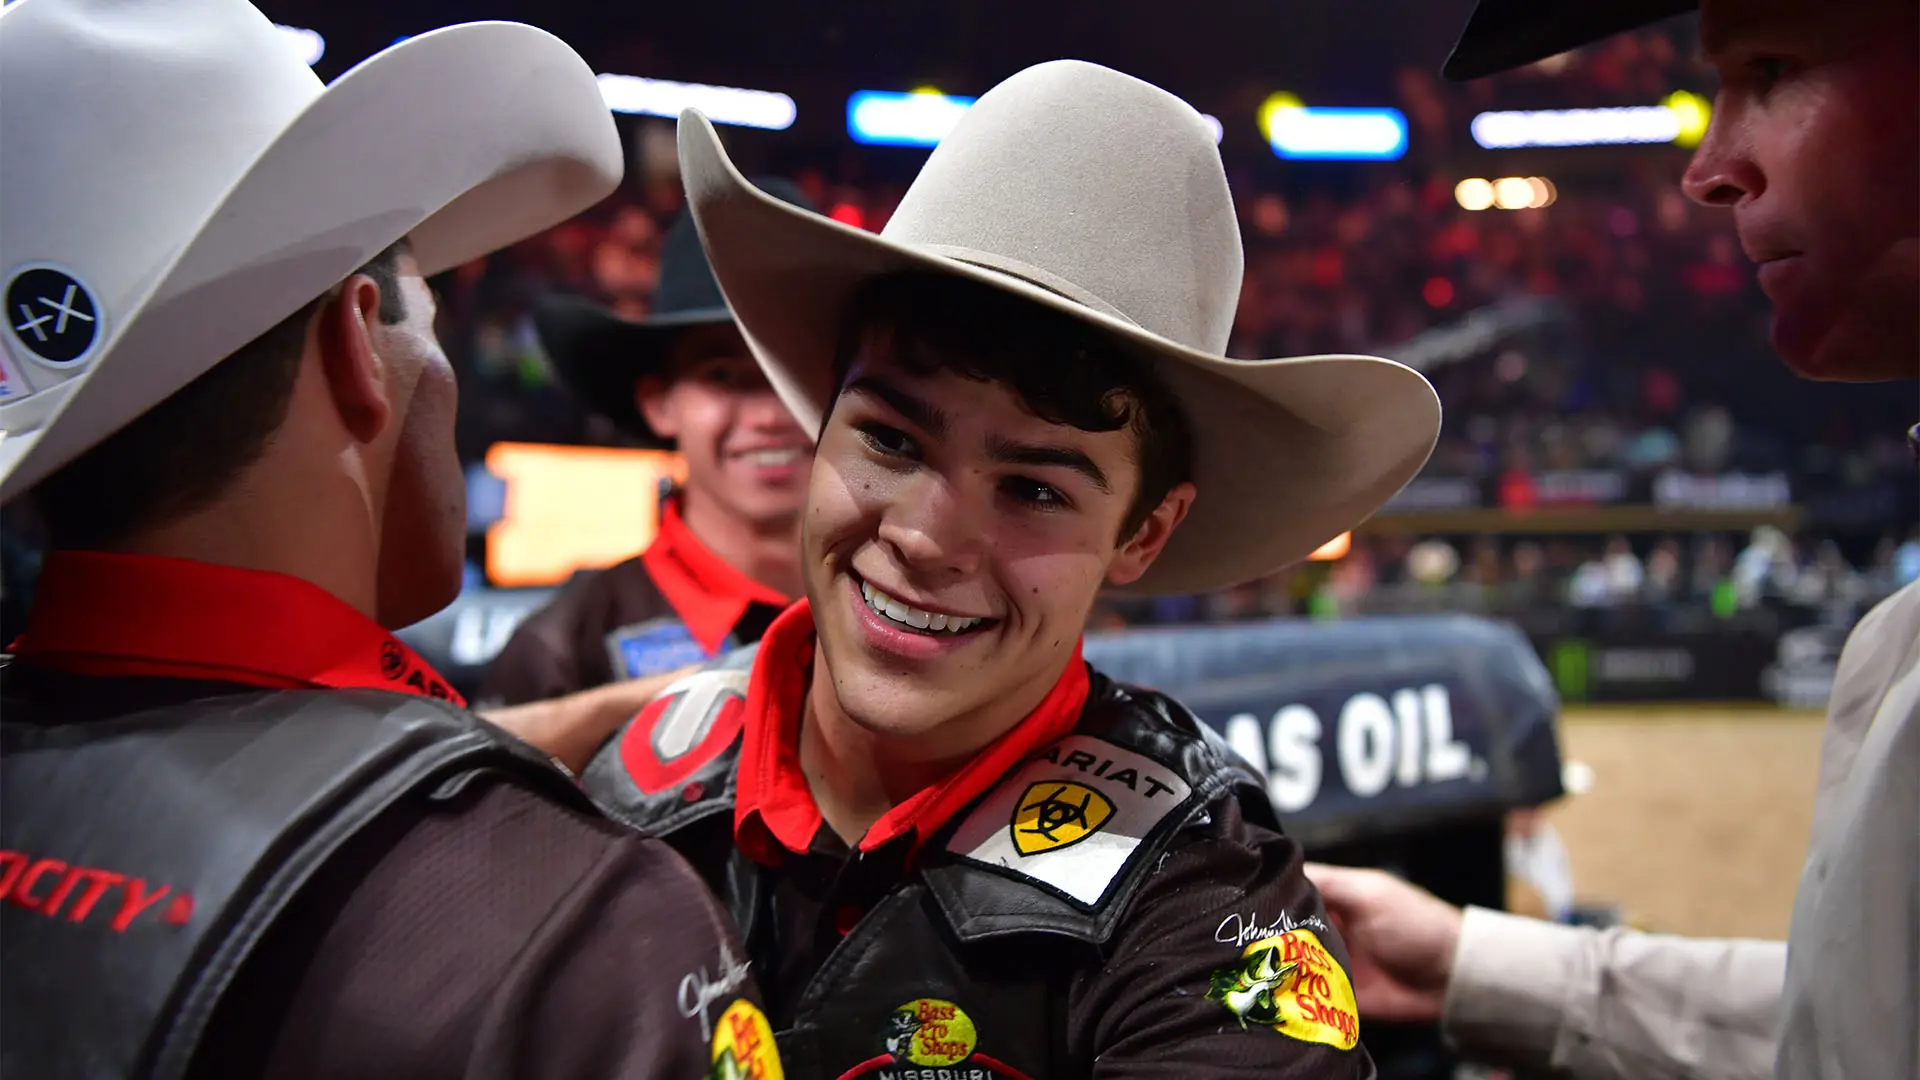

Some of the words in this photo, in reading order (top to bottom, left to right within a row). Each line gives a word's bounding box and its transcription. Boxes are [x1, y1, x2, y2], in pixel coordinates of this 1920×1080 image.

[1337, 683, 1472, 797] OIL
[1031, 747, 1174, 799] ARIAT
[1280, 933, 1332, 972] Bass
[1291, 960, 1330, 998] Pro
[1296, 994, 1357, 1046] Shops
